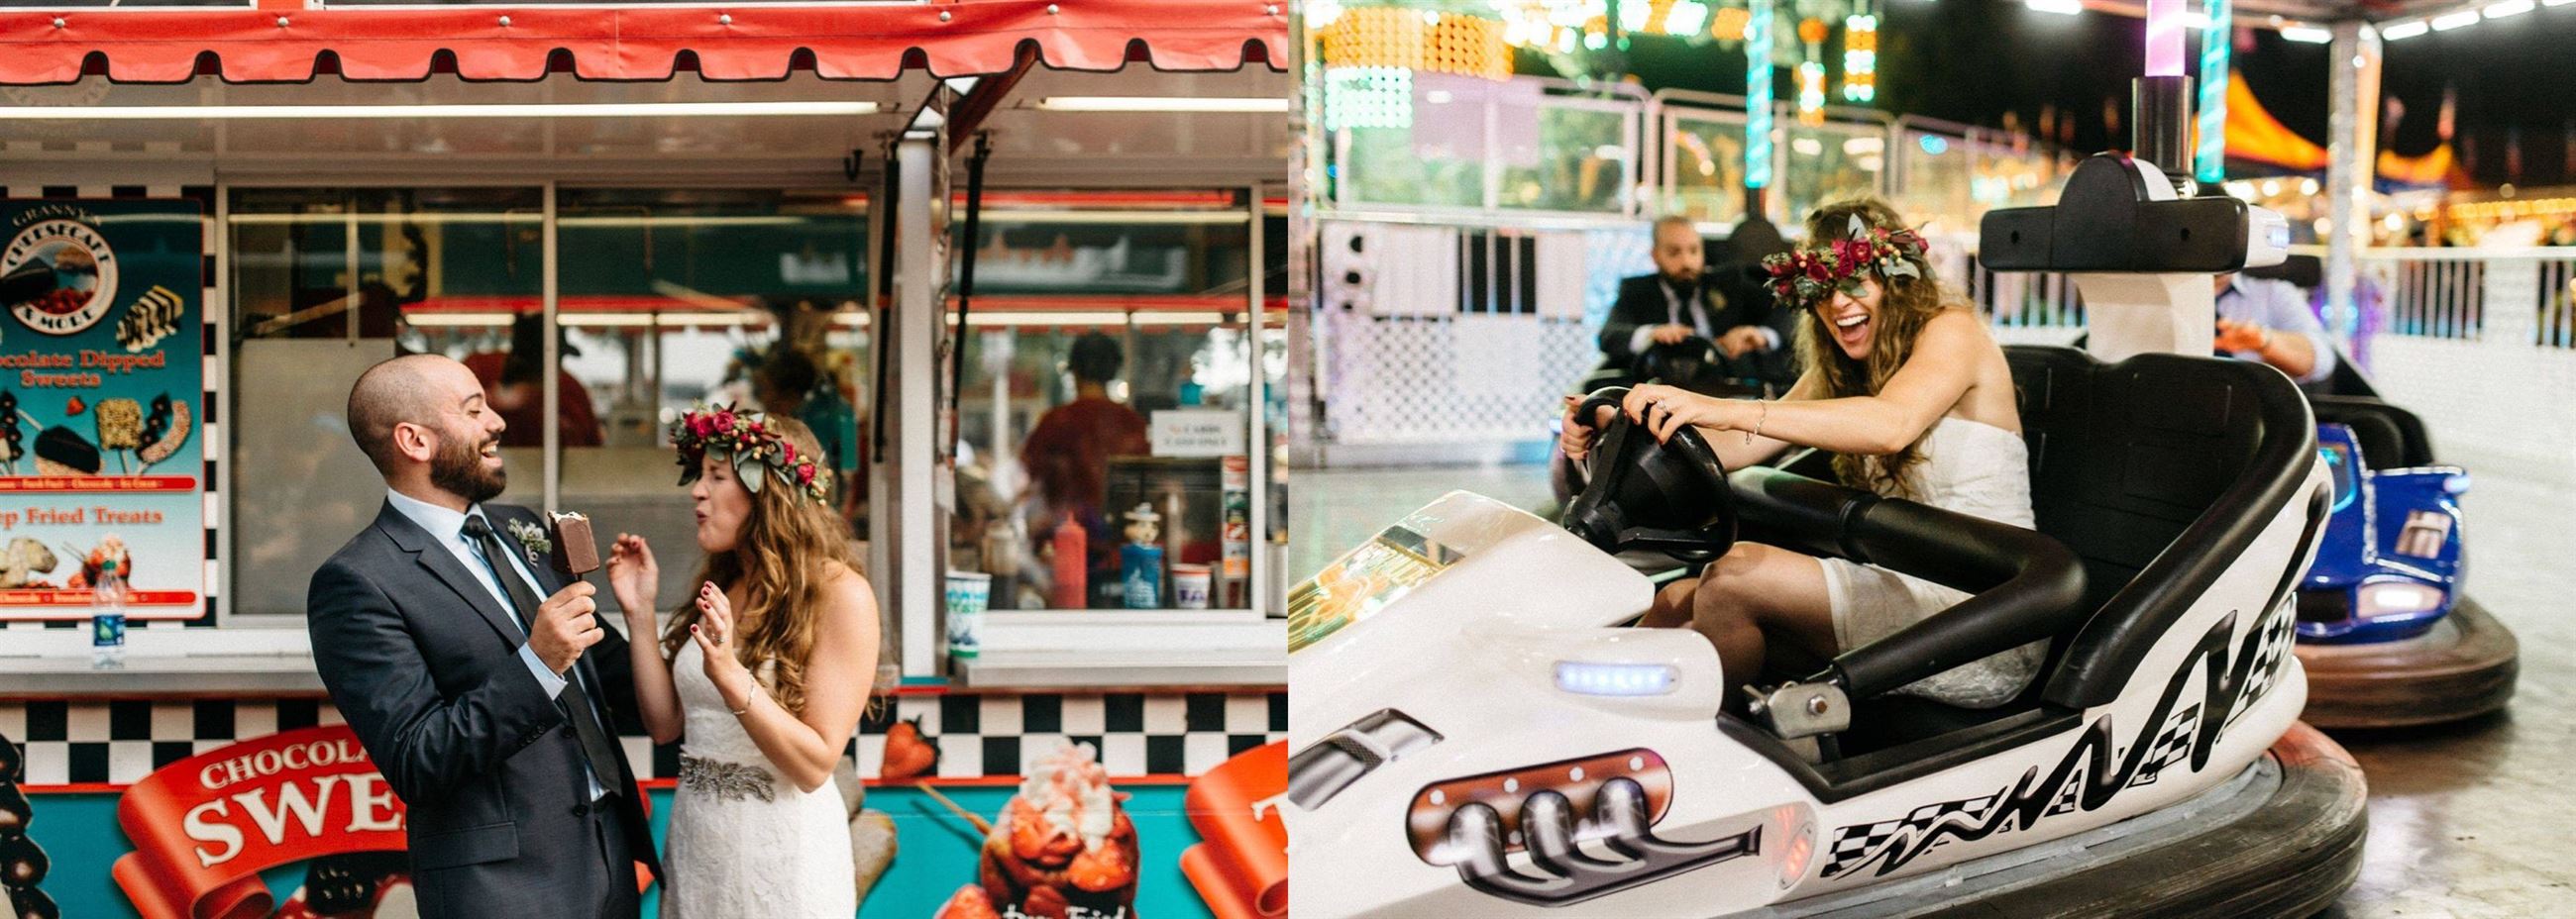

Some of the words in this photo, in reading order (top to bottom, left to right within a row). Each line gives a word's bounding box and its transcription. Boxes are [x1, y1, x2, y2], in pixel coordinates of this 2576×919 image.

[7, 224, 110, 266] CHEESECAKE
[40, 309, 97, 330] MORE
[79, 349, 165, 373] Dipped
[20, 369, 101, 387] Sweets
[26, 506, 84, 524] Fried
[92, 506, 163, 524] Treats
[182, 771, 407, 868] SWE
